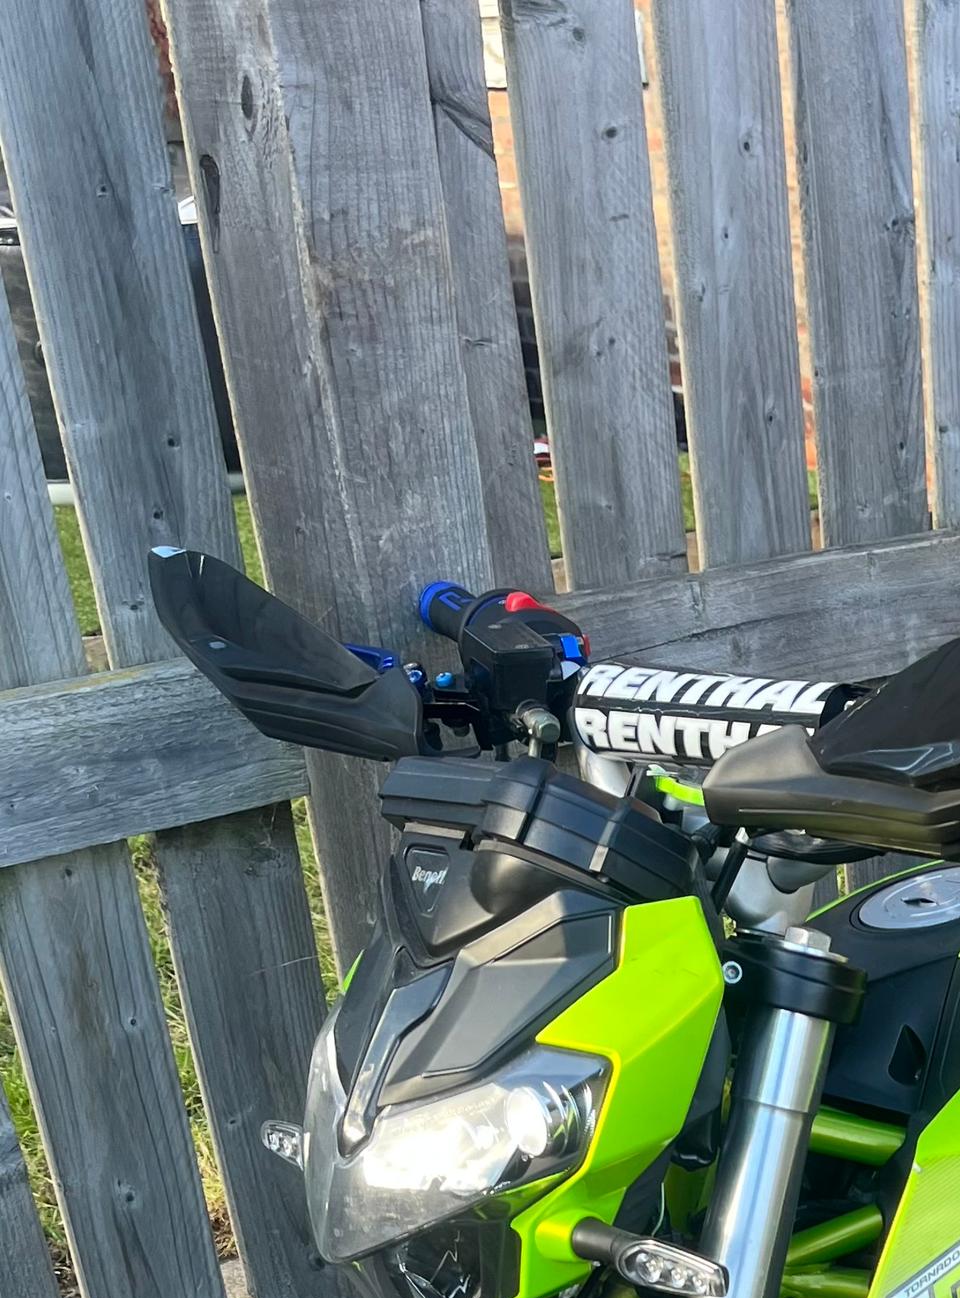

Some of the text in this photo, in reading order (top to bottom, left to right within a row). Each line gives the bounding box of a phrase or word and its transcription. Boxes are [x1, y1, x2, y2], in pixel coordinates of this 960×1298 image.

[577, 664, 840, 714] RENTHAL
[574, 708, 815, 760] RENTH
[904, 1251, 960, 1298] TORNADO
